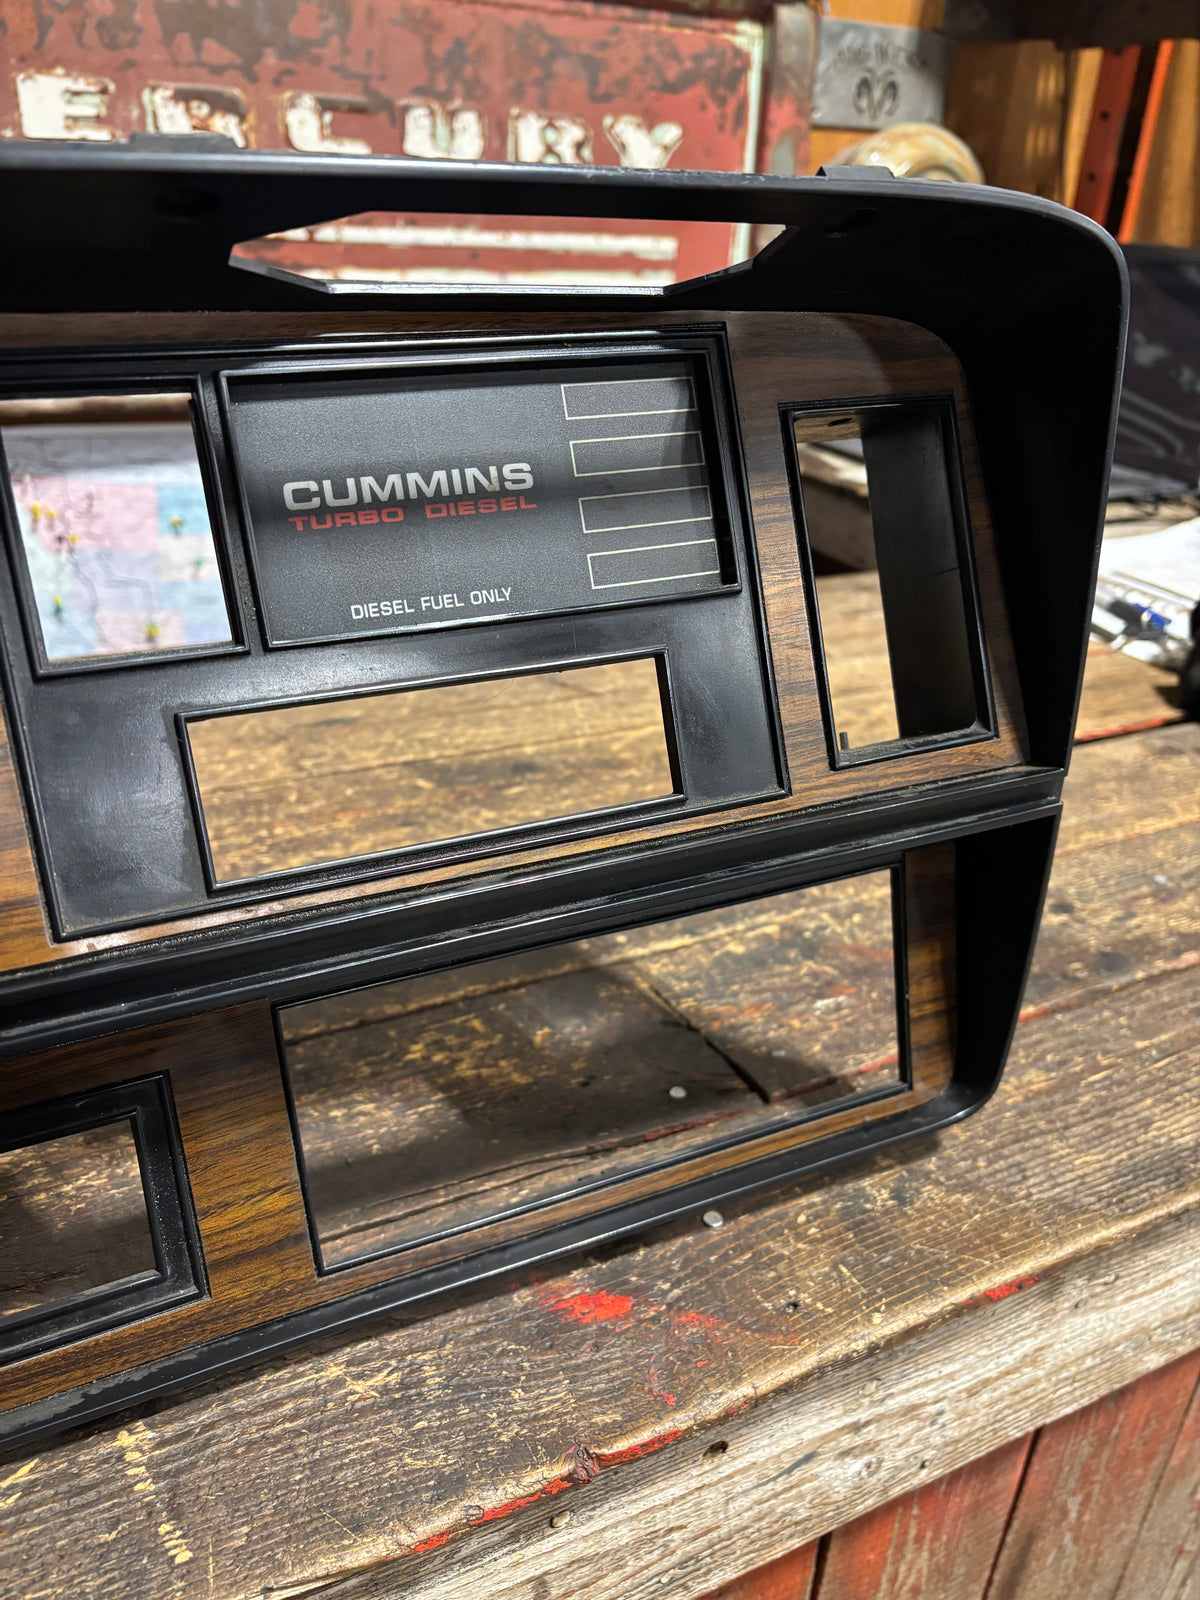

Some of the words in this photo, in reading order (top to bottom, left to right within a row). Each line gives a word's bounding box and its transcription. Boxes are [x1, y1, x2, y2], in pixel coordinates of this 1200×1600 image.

[282, 462, 534, 512] CUMMINS
[288, 507, 405, 532] TURBO
[425, 496, 537, 519] DIESEL
[350, 599, 415, 620] DIESEL
[420, 593, 465, 612] FUEL
[470, 587, 512, 606] ONLY
